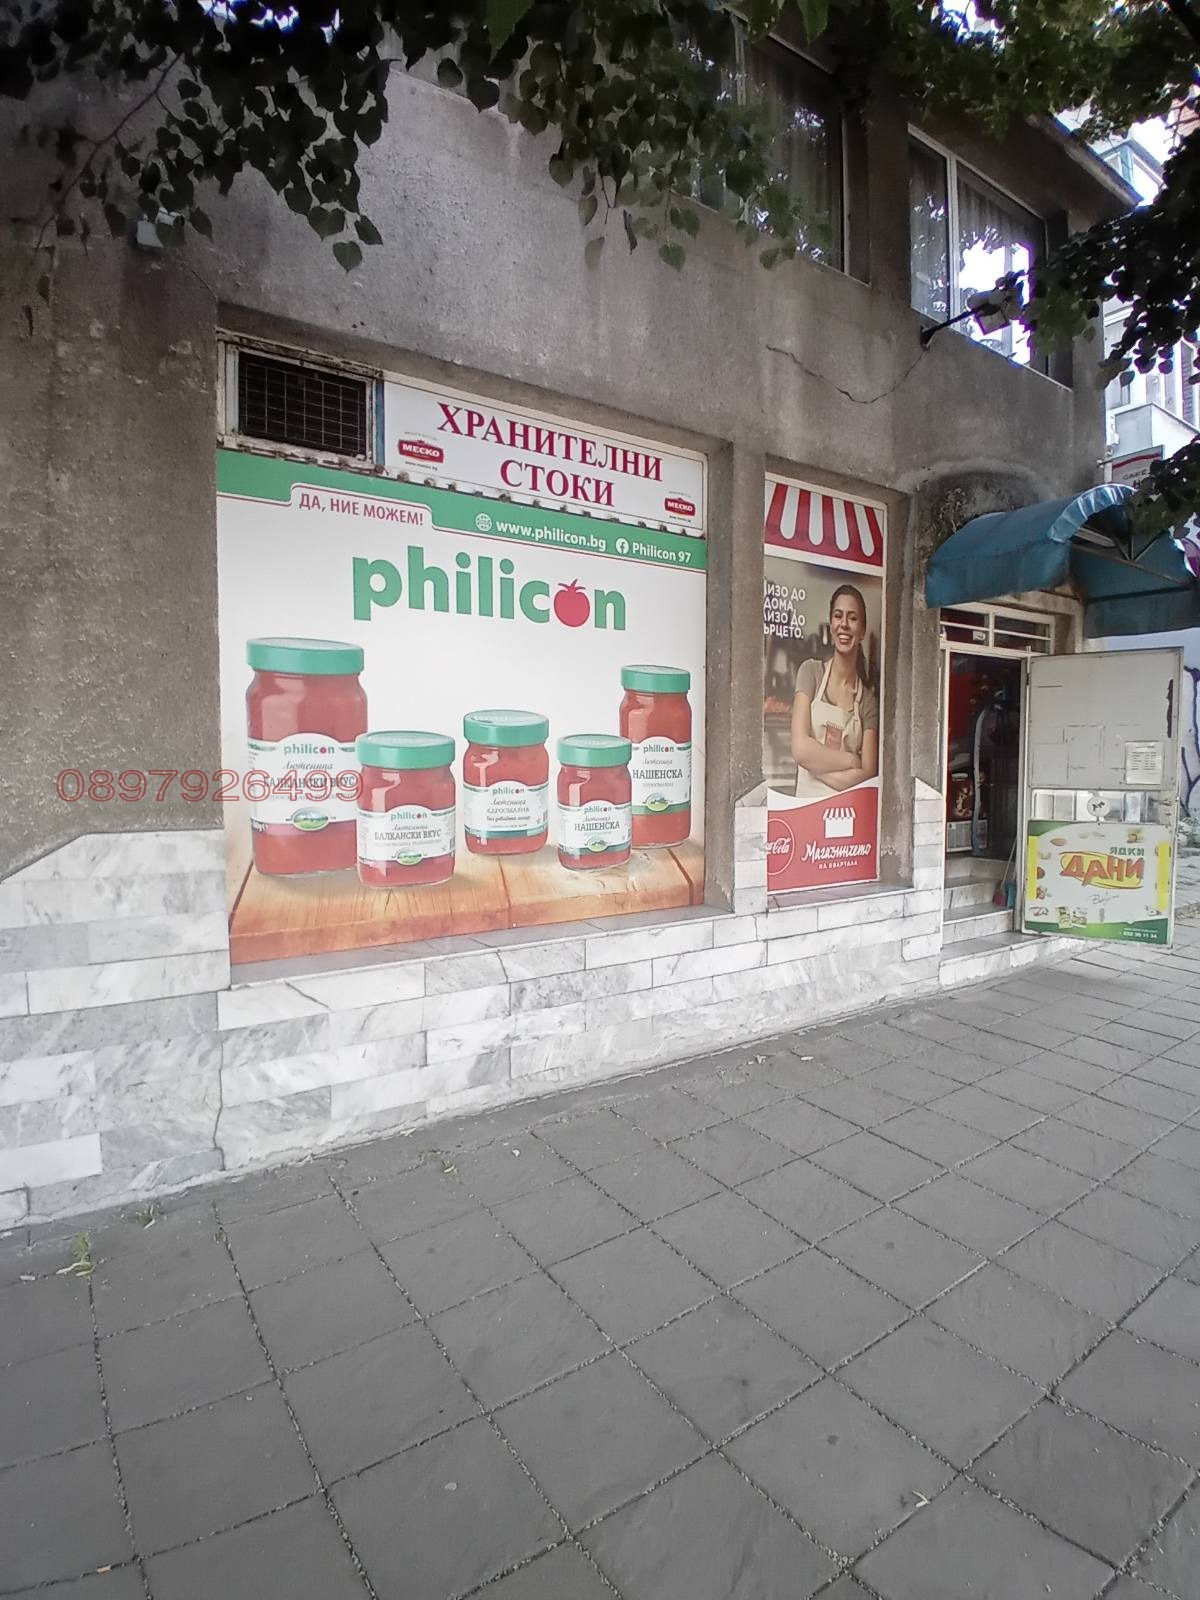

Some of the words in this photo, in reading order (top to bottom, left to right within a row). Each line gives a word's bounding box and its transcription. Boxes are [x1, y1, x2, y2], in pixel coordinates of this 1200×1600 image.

[402, 443, 440, 458] МЕСКО
[437, 402, 663, 482] ХРАНИТЕЛНИ
[500, 459, 614, 507] СТОКИ
[299, 493, 326, 512] ДА,
[330, 498, 359, 515] НИЕ
[363, 504, 423, 526] МОЖЕМ!
[496, 520, 606, 551] www.philicon.bg
[632, 542, 676, 560] Philicon
[677, 551, 692, 563] 97
[352, 545, 626, 631] philicon
[791, 588, 806, 601] ДО
[791, 614, 806, 627] ДО
[283, 743, 335, 756] philicon
[632, 769, 683, 779] НАШЕНСКА
[374, 830, 422, 841] БАЛКАНСКИ
[423, 829, 442, 839] ВКУС
[574, 821, 620, 831] НАШЕНСКА
[801, 840, 872, 863] Магазинчето
[1109, 846, 1145, 857] ЯДКИ
[1060, 855, 1145, 887] ДАНИ
